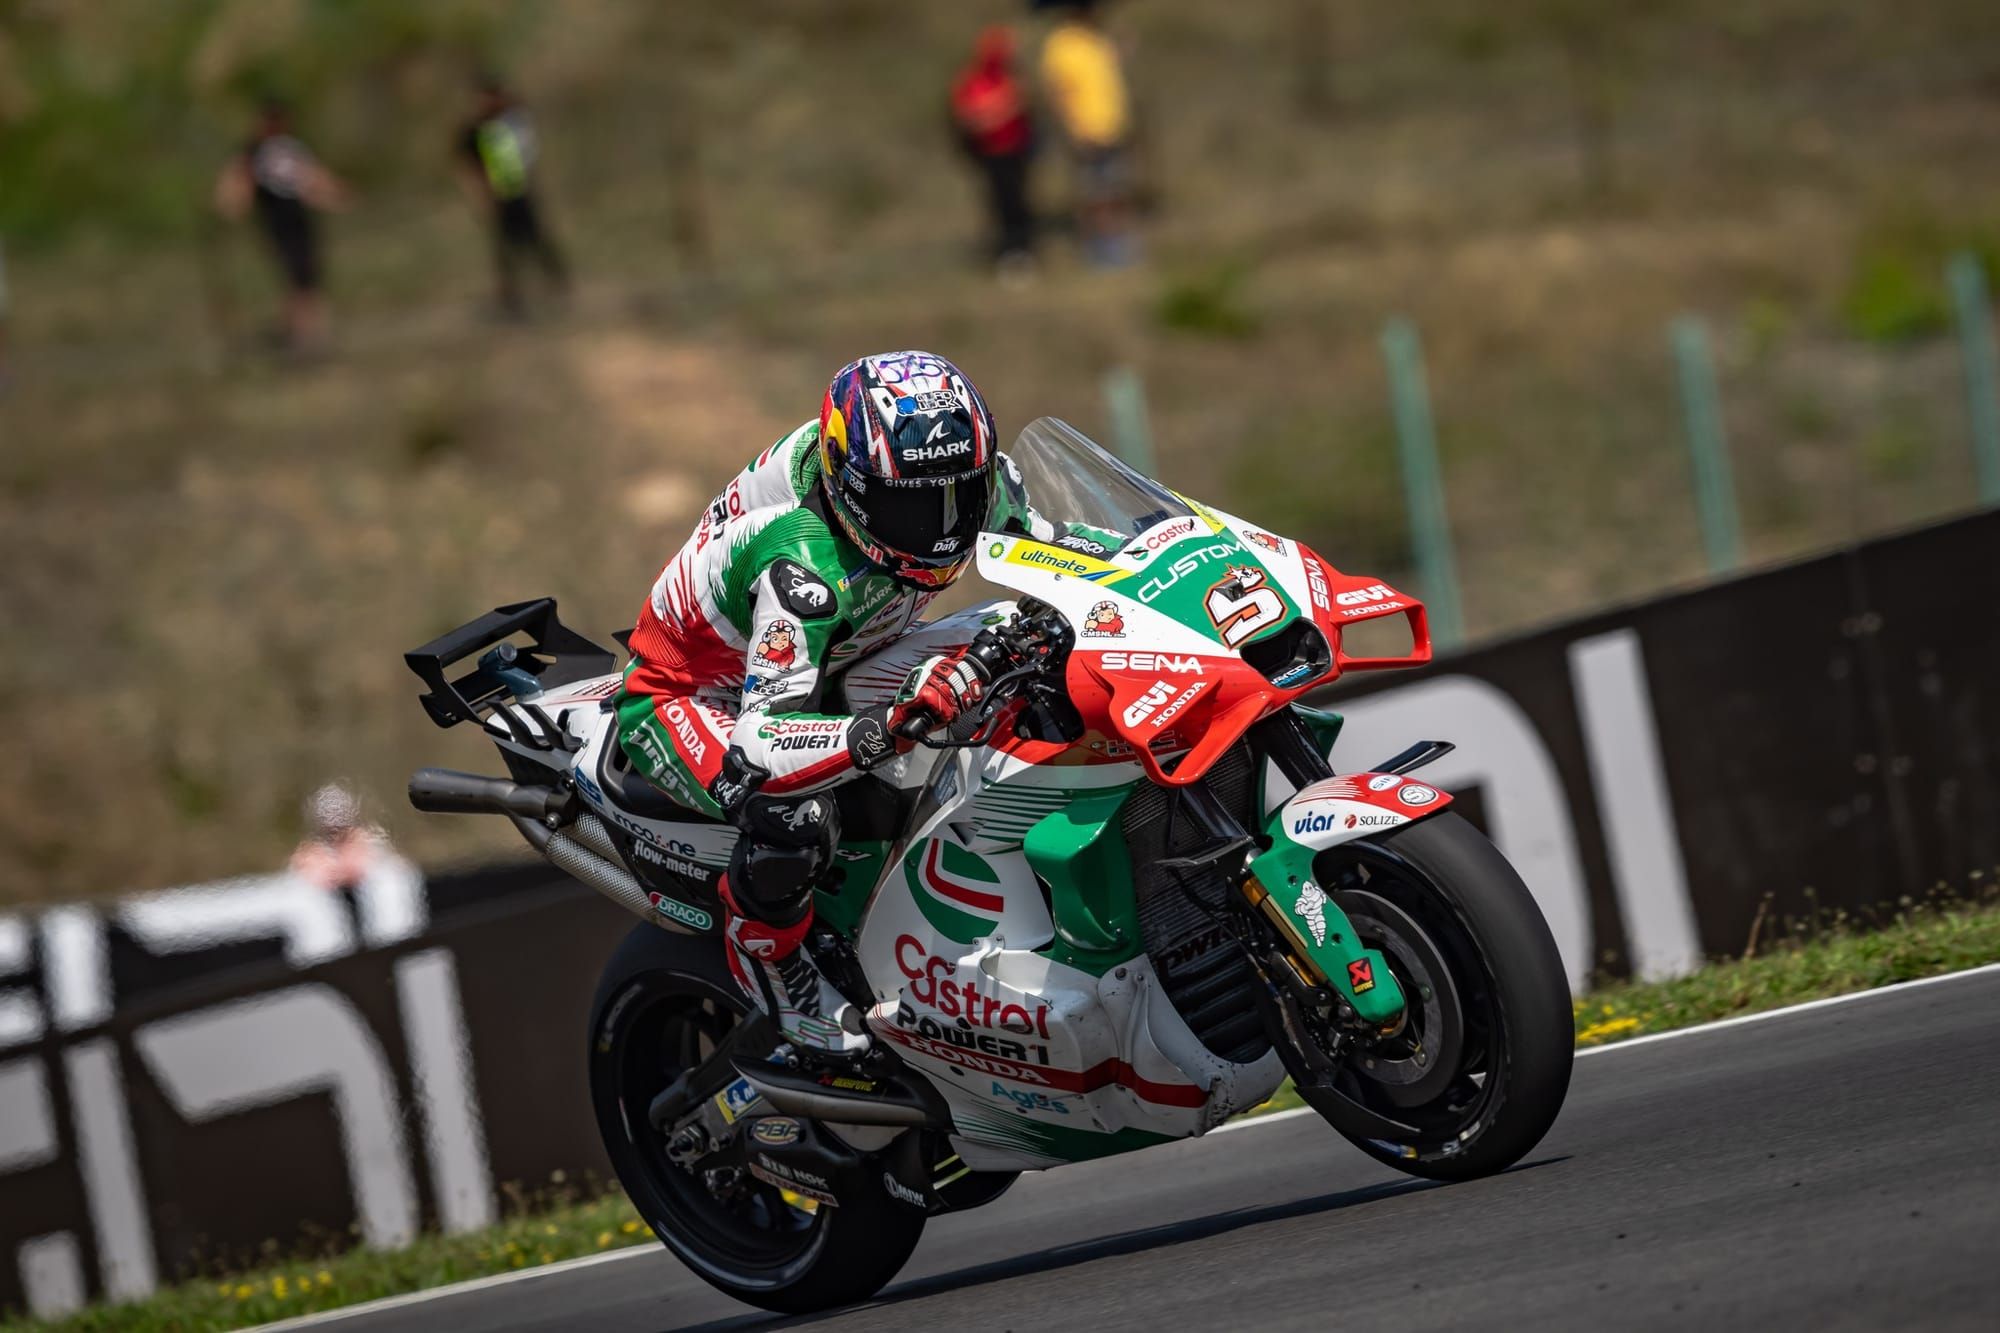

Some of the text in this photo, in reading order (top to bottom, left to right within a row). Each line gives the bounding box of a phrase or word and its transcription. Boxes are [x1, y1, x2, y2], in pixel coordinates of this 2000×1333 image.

[903, 440, 972, 462] SHARK
[885, 477, 922, 488] GIVES
[930, 476, 955, 487] YOU
[932, 539, 960, 553] Dafy
[1020, 549, 1088, 574] ultimate
[1137, 541, 1249, 604] CUSTOM
[1304, 557, 1331, 612] SENA
[1336, 584, 1397, 606] GIVI
[852, 582, 894, 618] SHARK
[1204, 565, 1288, 651] 5
[1342, 601, 1406, 617] HONDA
[1101, 652, 1204, 675] SENA
[1122, 680, 1178, 728] GIVI
[1150, 682, 1208, 727] HONDA
[780, 721, 843, 735] Castrol
[771, 734, 842, 752] POWER1
[1294, 811, 1336, 835] viar
[1359, 815, 1399, 826] SOLIZE
[634, 838, 711, 882] flow-meter
[657, 896, 707, 926] DRACO
[895, 934, 1050, 1040] Castrol
[896, 1000, 1050, 1065] POWER1
[907, 1036, 1051, 1084] HONDA
